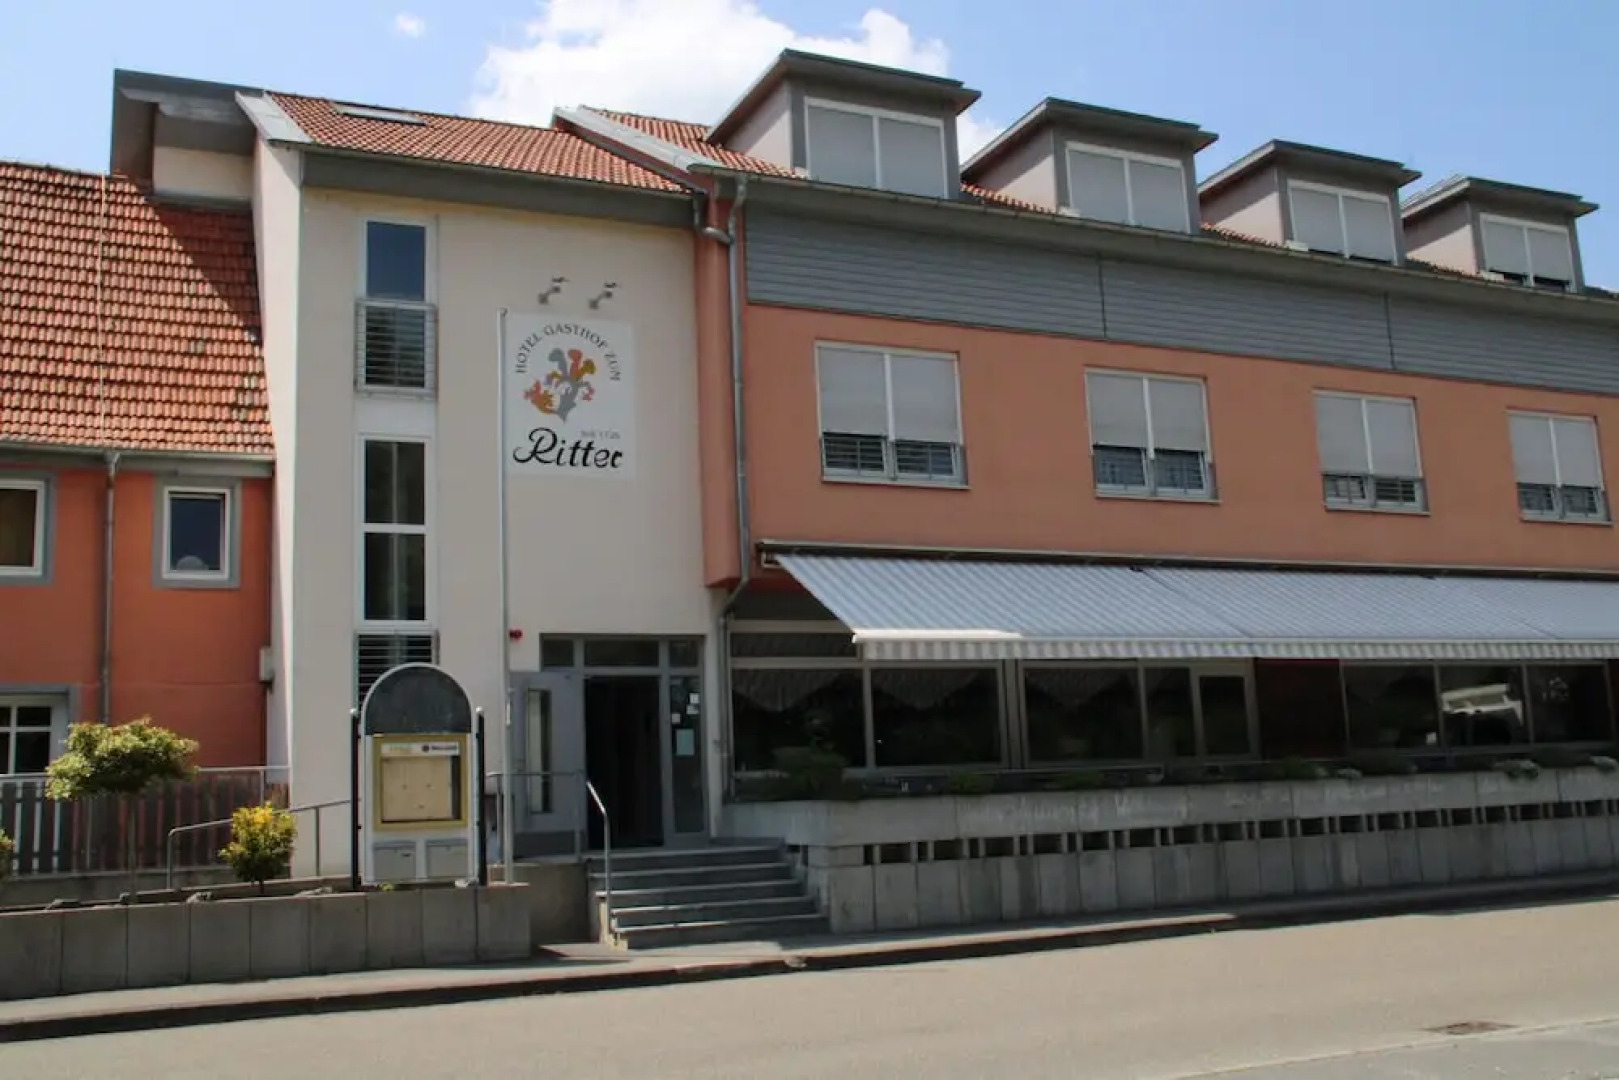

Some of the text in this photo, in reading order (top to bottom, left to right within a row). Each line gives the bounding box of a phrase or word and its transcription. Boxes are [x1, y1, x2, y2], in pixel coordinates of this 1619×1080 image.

[515, 323, 621, 381] HOTEL GASTHOF ZUM
[513, 427, 623, 468] Ritter
